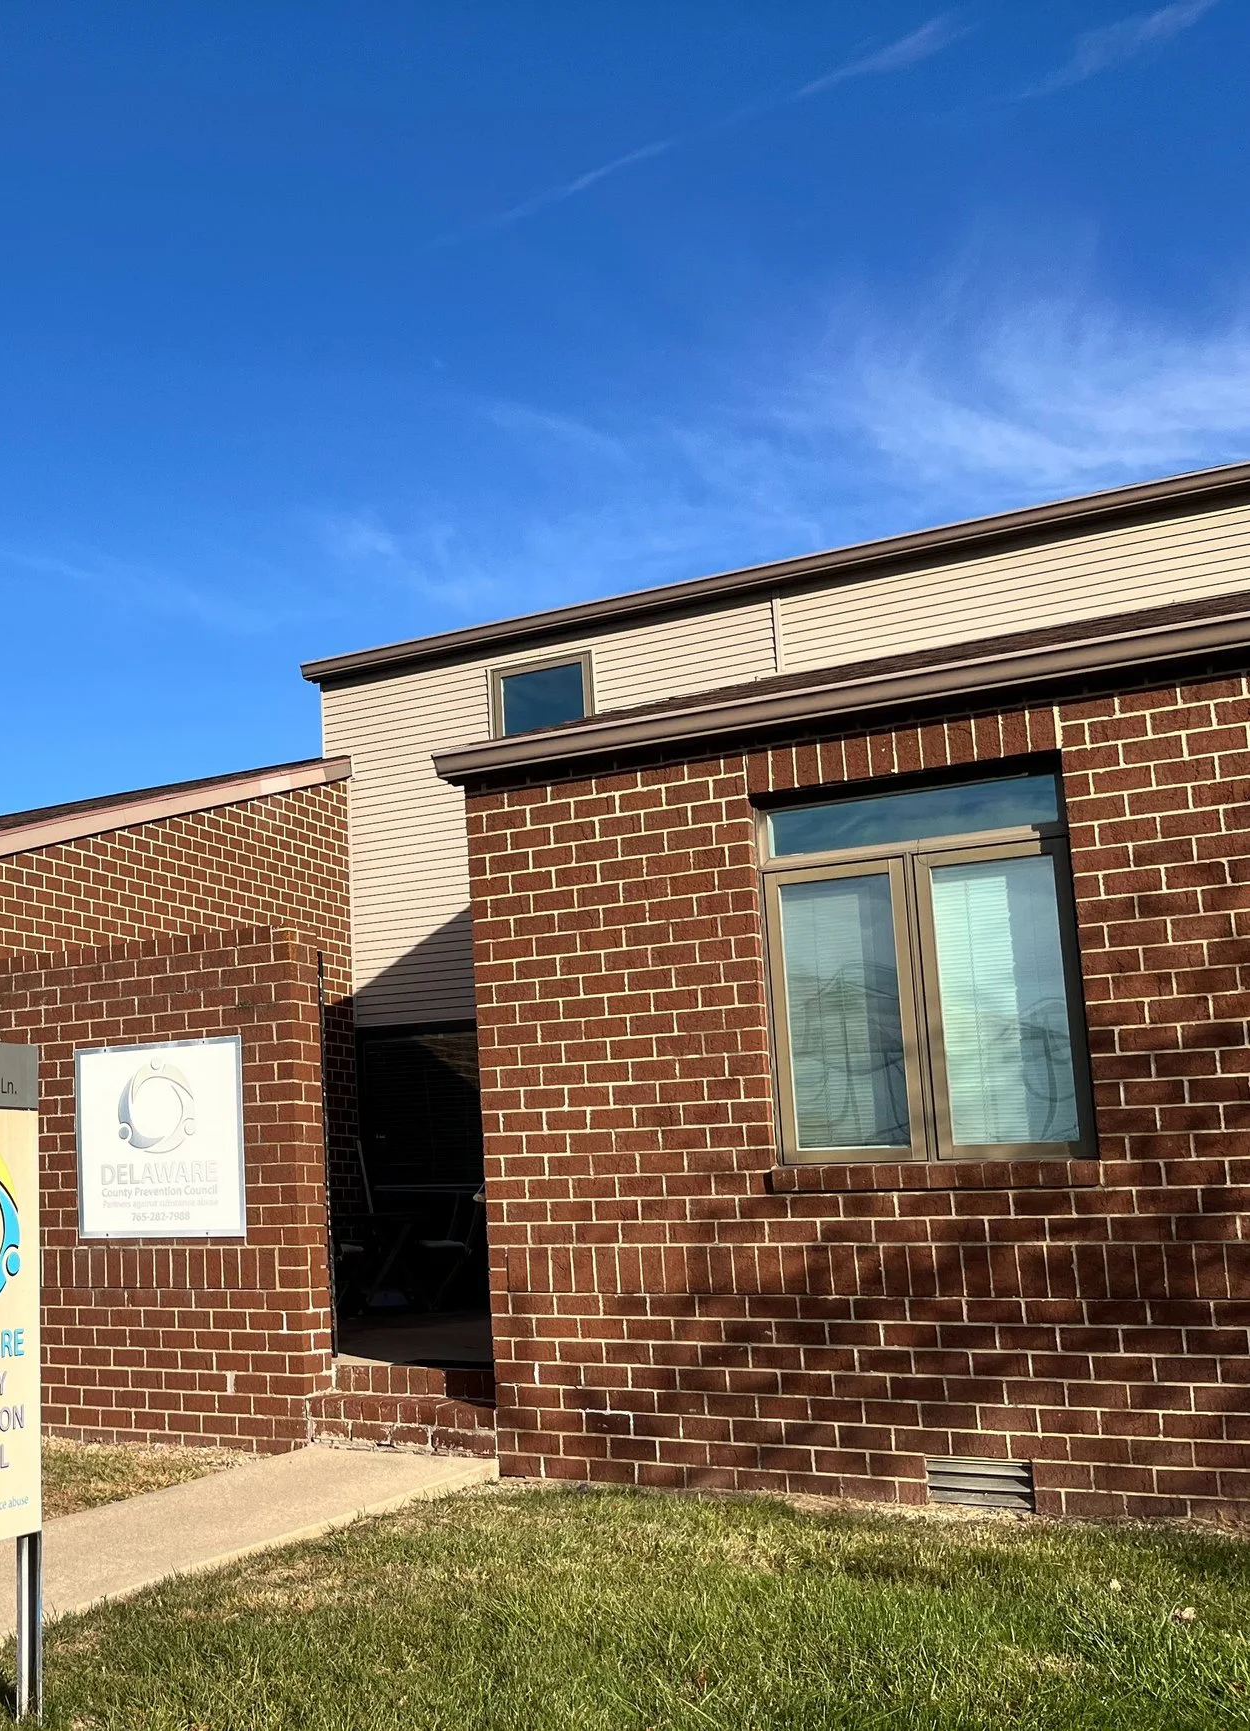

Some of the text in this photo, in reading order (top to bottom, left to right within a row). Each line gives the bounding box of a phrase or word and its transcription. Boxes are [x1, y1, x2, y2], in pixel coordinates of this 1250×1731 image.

[1, 1077, 18, 1095] Ln.
[100, 1159, 219, 1186] DELAWARE
[101, 1183, 218, 1199] County Prevention Council
[8, 1494, 29, 1508] abuse
